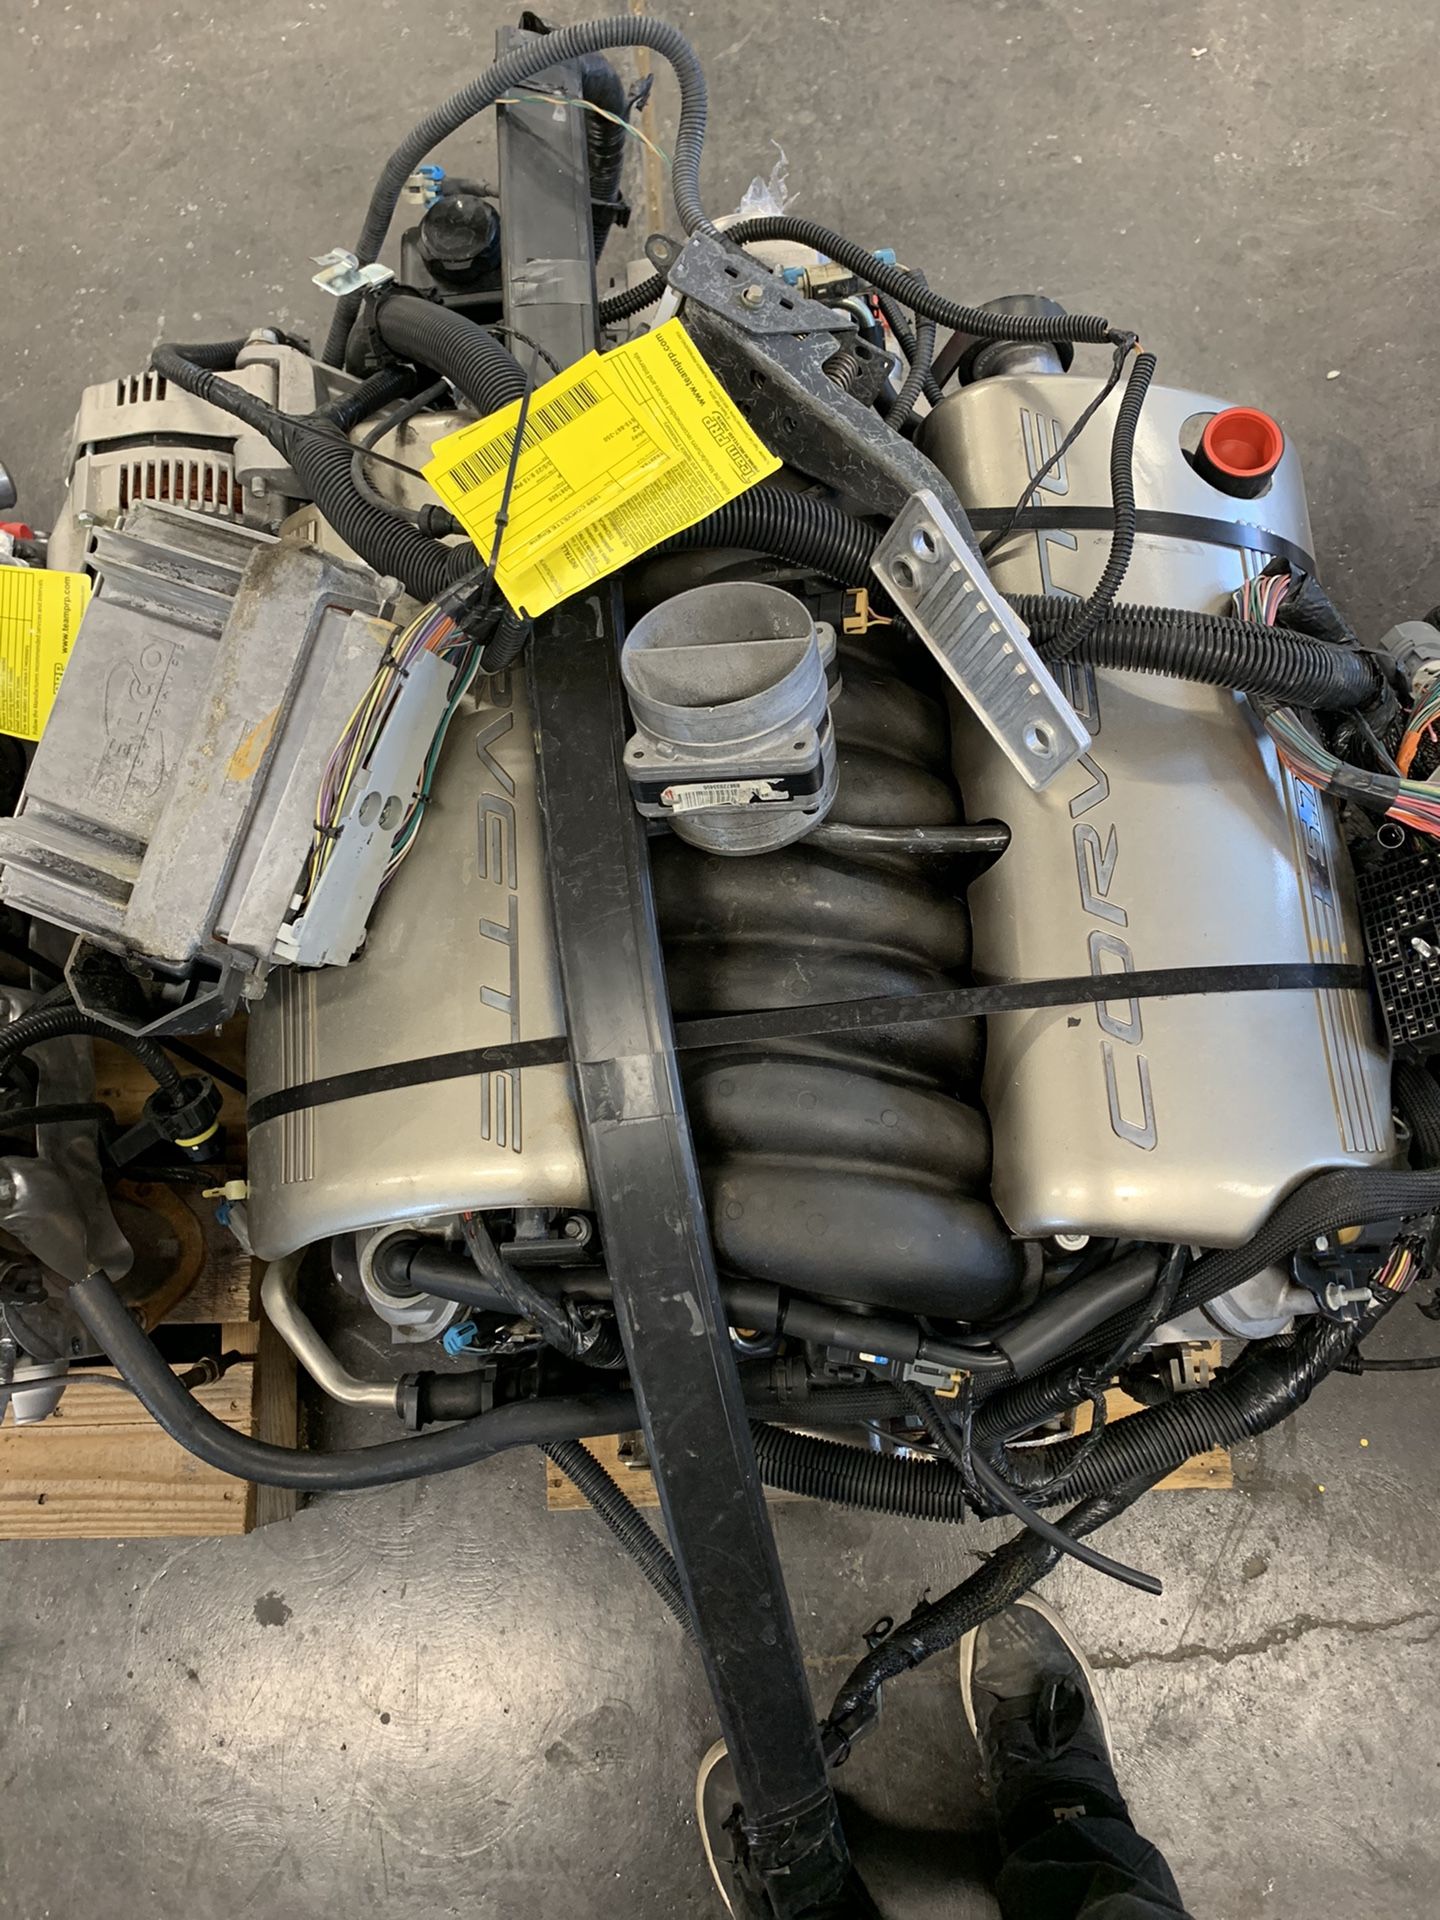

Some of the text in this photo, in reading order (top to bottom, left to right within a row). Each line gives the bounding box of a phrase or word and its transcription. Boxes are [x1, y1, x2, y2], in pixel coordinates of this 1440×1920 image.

[653, 331, 707, 407] www.teamprp.com
[700, 411, 758, 485] Team PRP
[56, 576, 74, 653] www.teamprp.com
